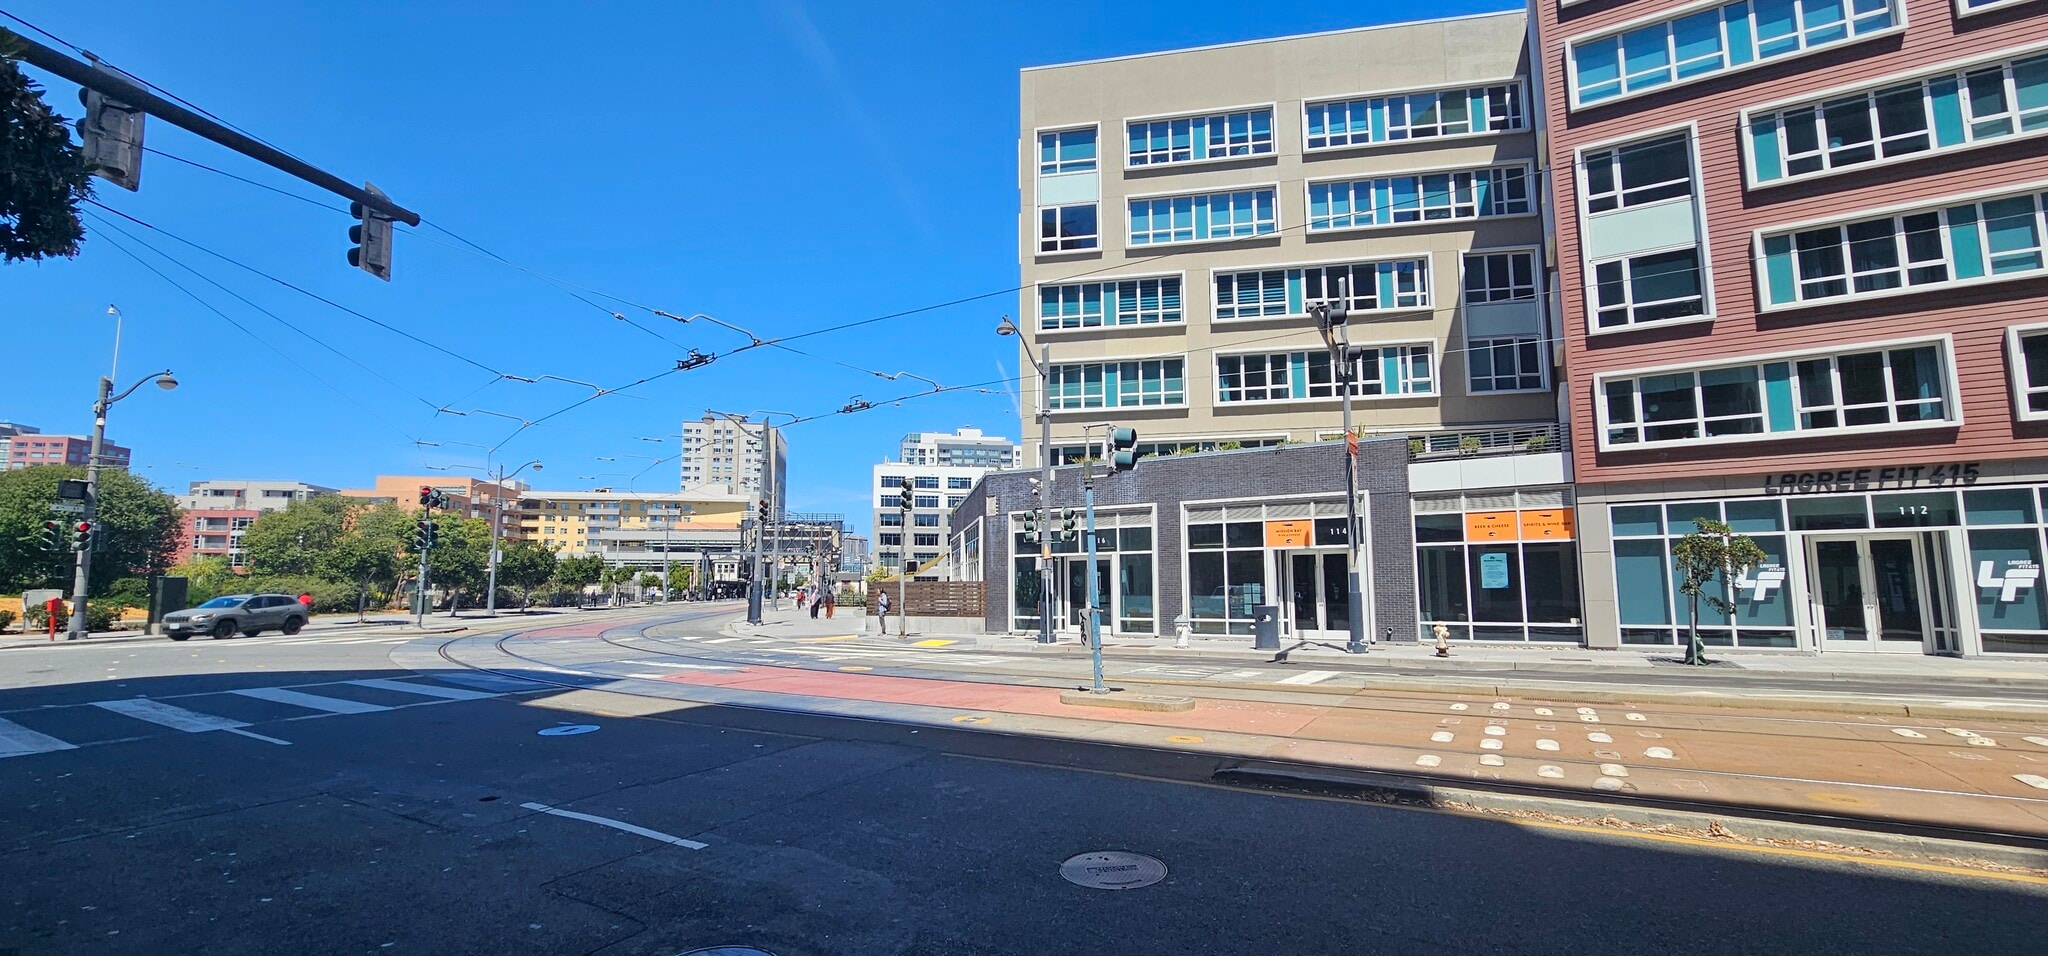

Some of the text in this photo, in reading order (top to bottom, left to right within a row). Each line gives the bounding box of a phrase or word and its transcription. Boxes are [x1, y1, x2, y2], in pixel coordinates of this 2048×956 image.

[1765, 463, 1980, 494] LAGREE FIT 415
[1899, 505, 1928, 515] 112
[1330, 527, 1347, 535] 114
